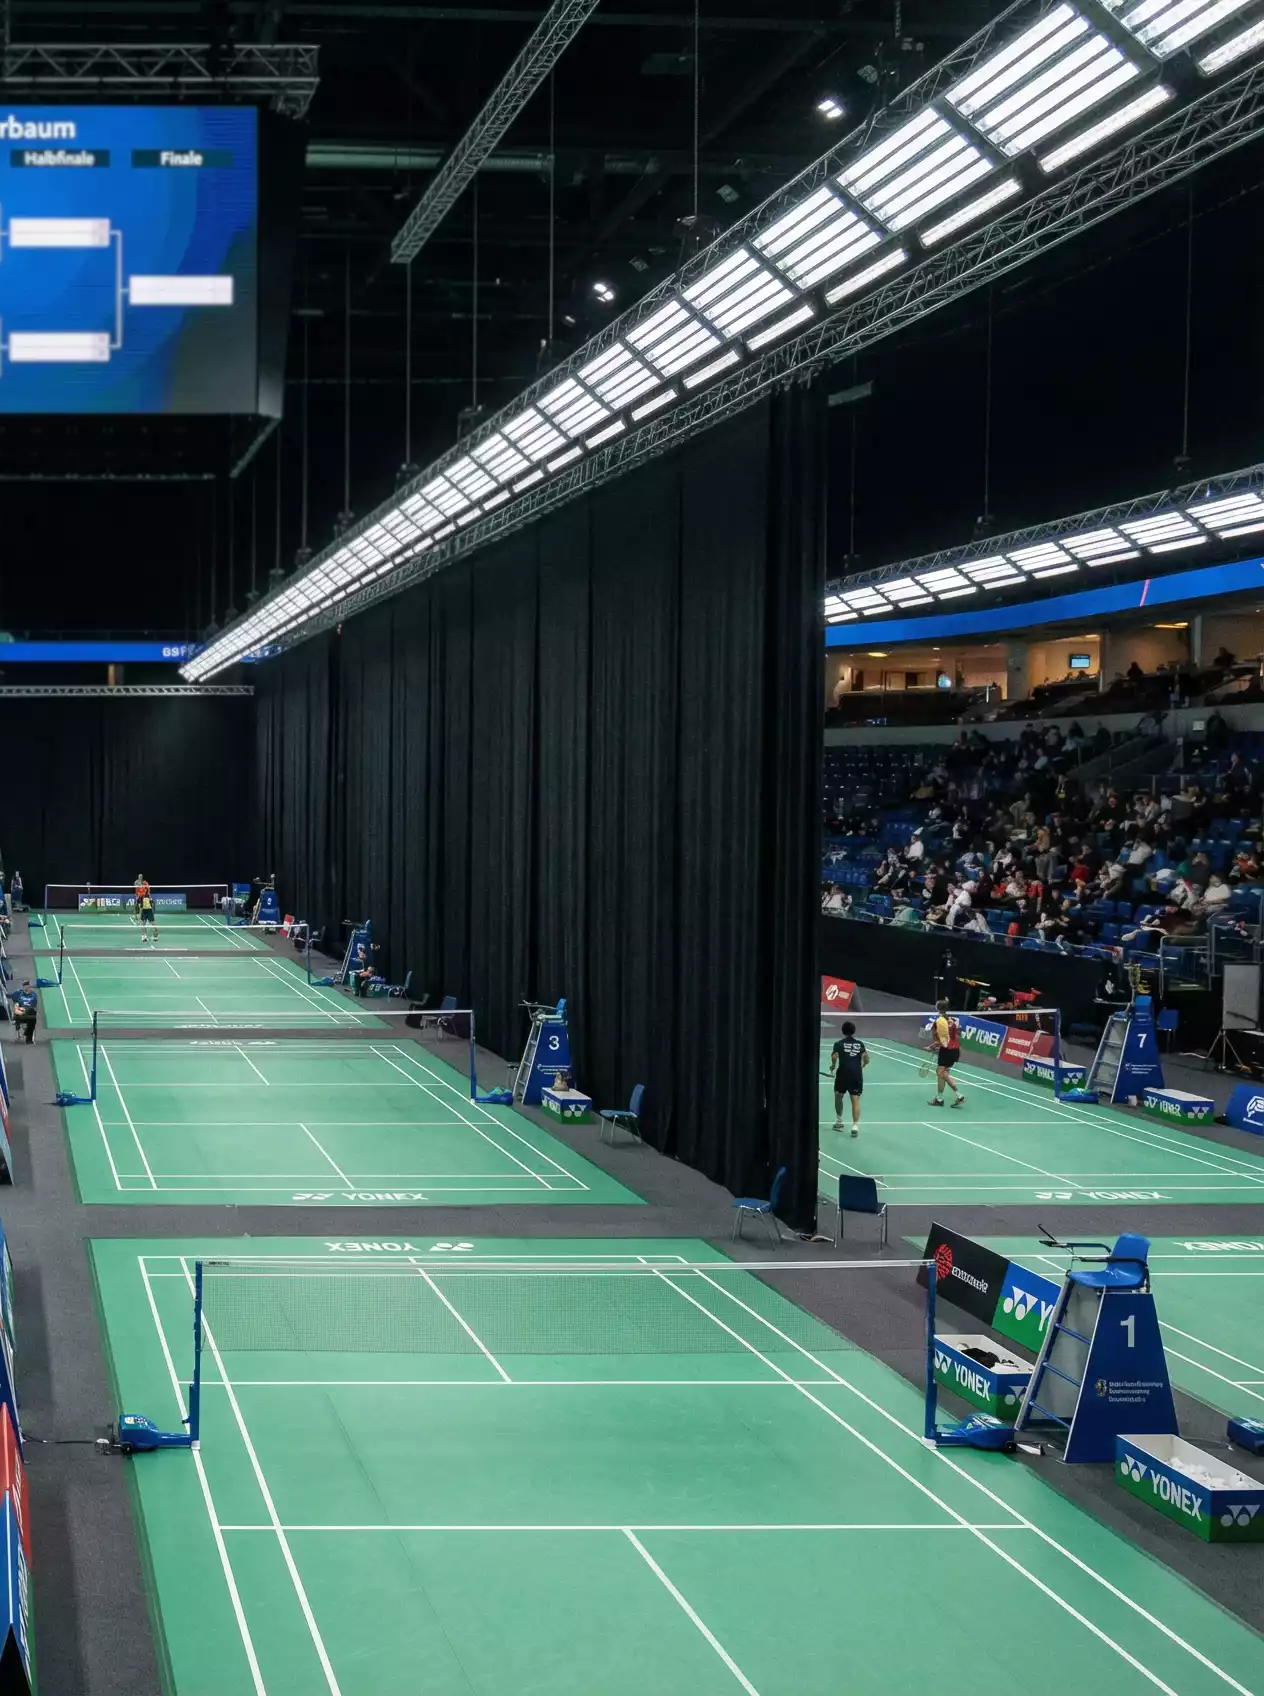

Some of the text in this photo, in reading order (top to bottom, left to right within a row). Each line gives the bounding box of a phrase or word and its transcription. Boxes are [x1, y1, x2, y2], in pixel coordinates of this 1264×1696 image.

[23, 150, 96, 166] Halbfinale
[160, 150, 203, 166] Finale
[548, 1035, 560, 1051] 3
[1137, 1033, 1148, 1049] 7
[341, 1192, 429, 1201] YONEX
[324, 1242, 422, 1251] YONEX
[1119, 1315, 1136, 1348] 1
[954, 1361, 991, 1402] YONEX
[1150, 1469, 1203, 1522] YONEX
